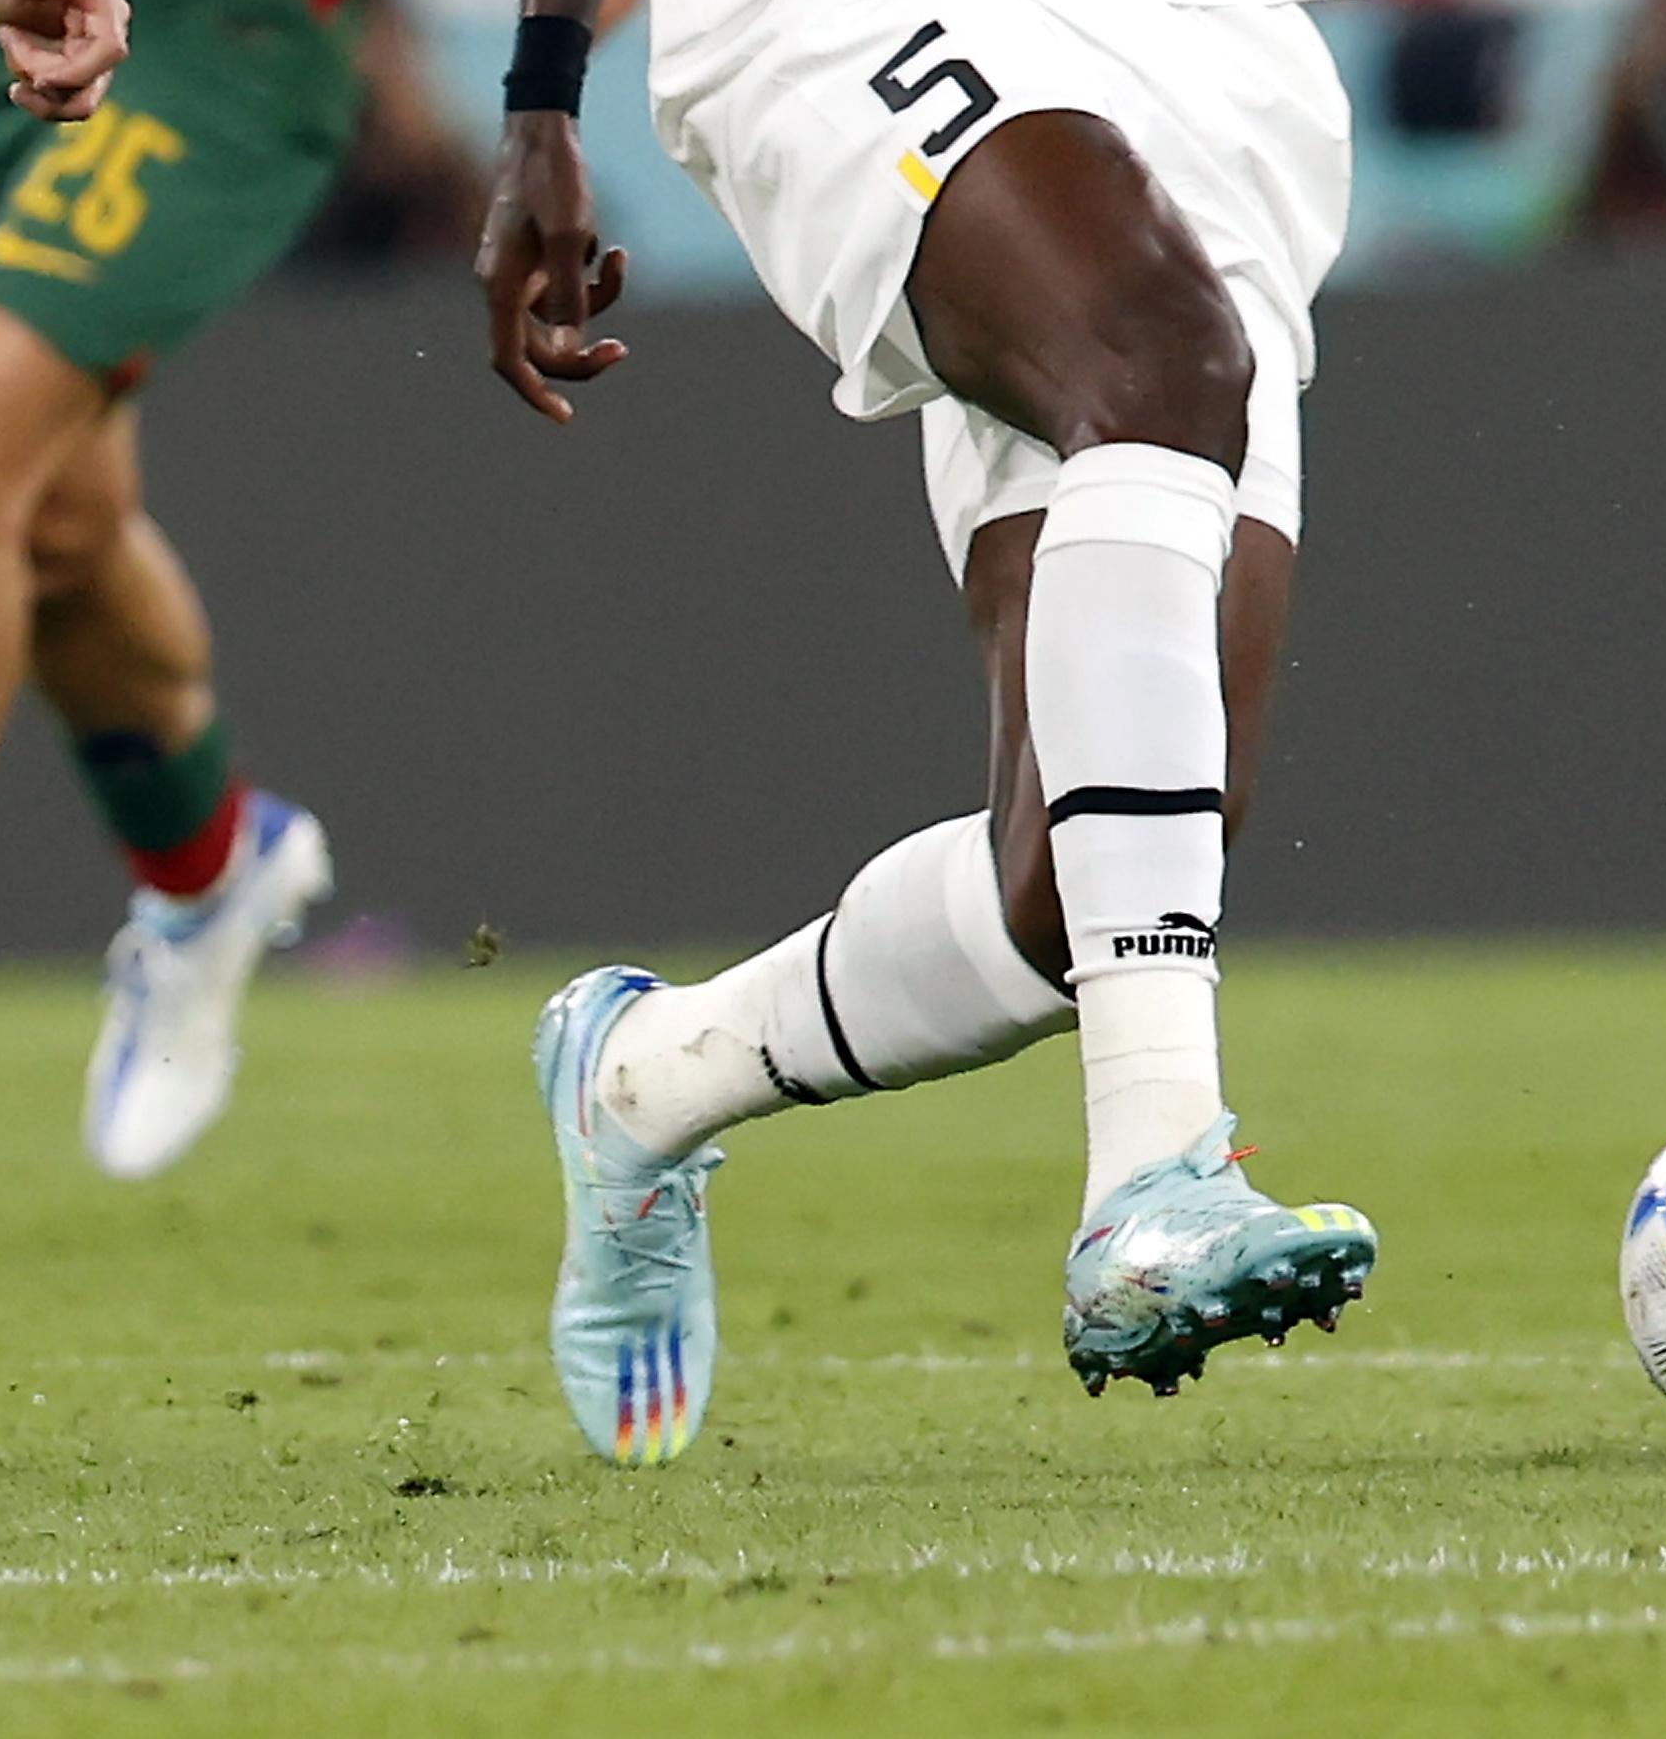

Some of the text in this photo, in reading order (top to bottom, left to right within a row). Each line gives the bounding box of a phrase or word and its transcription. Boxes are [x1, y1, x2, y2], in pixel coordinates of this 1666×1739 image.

[868, 20, 1000, 157] 5
[11, 100, 185, 256] 25
[1113, 934, 1213, 959] PUMA
